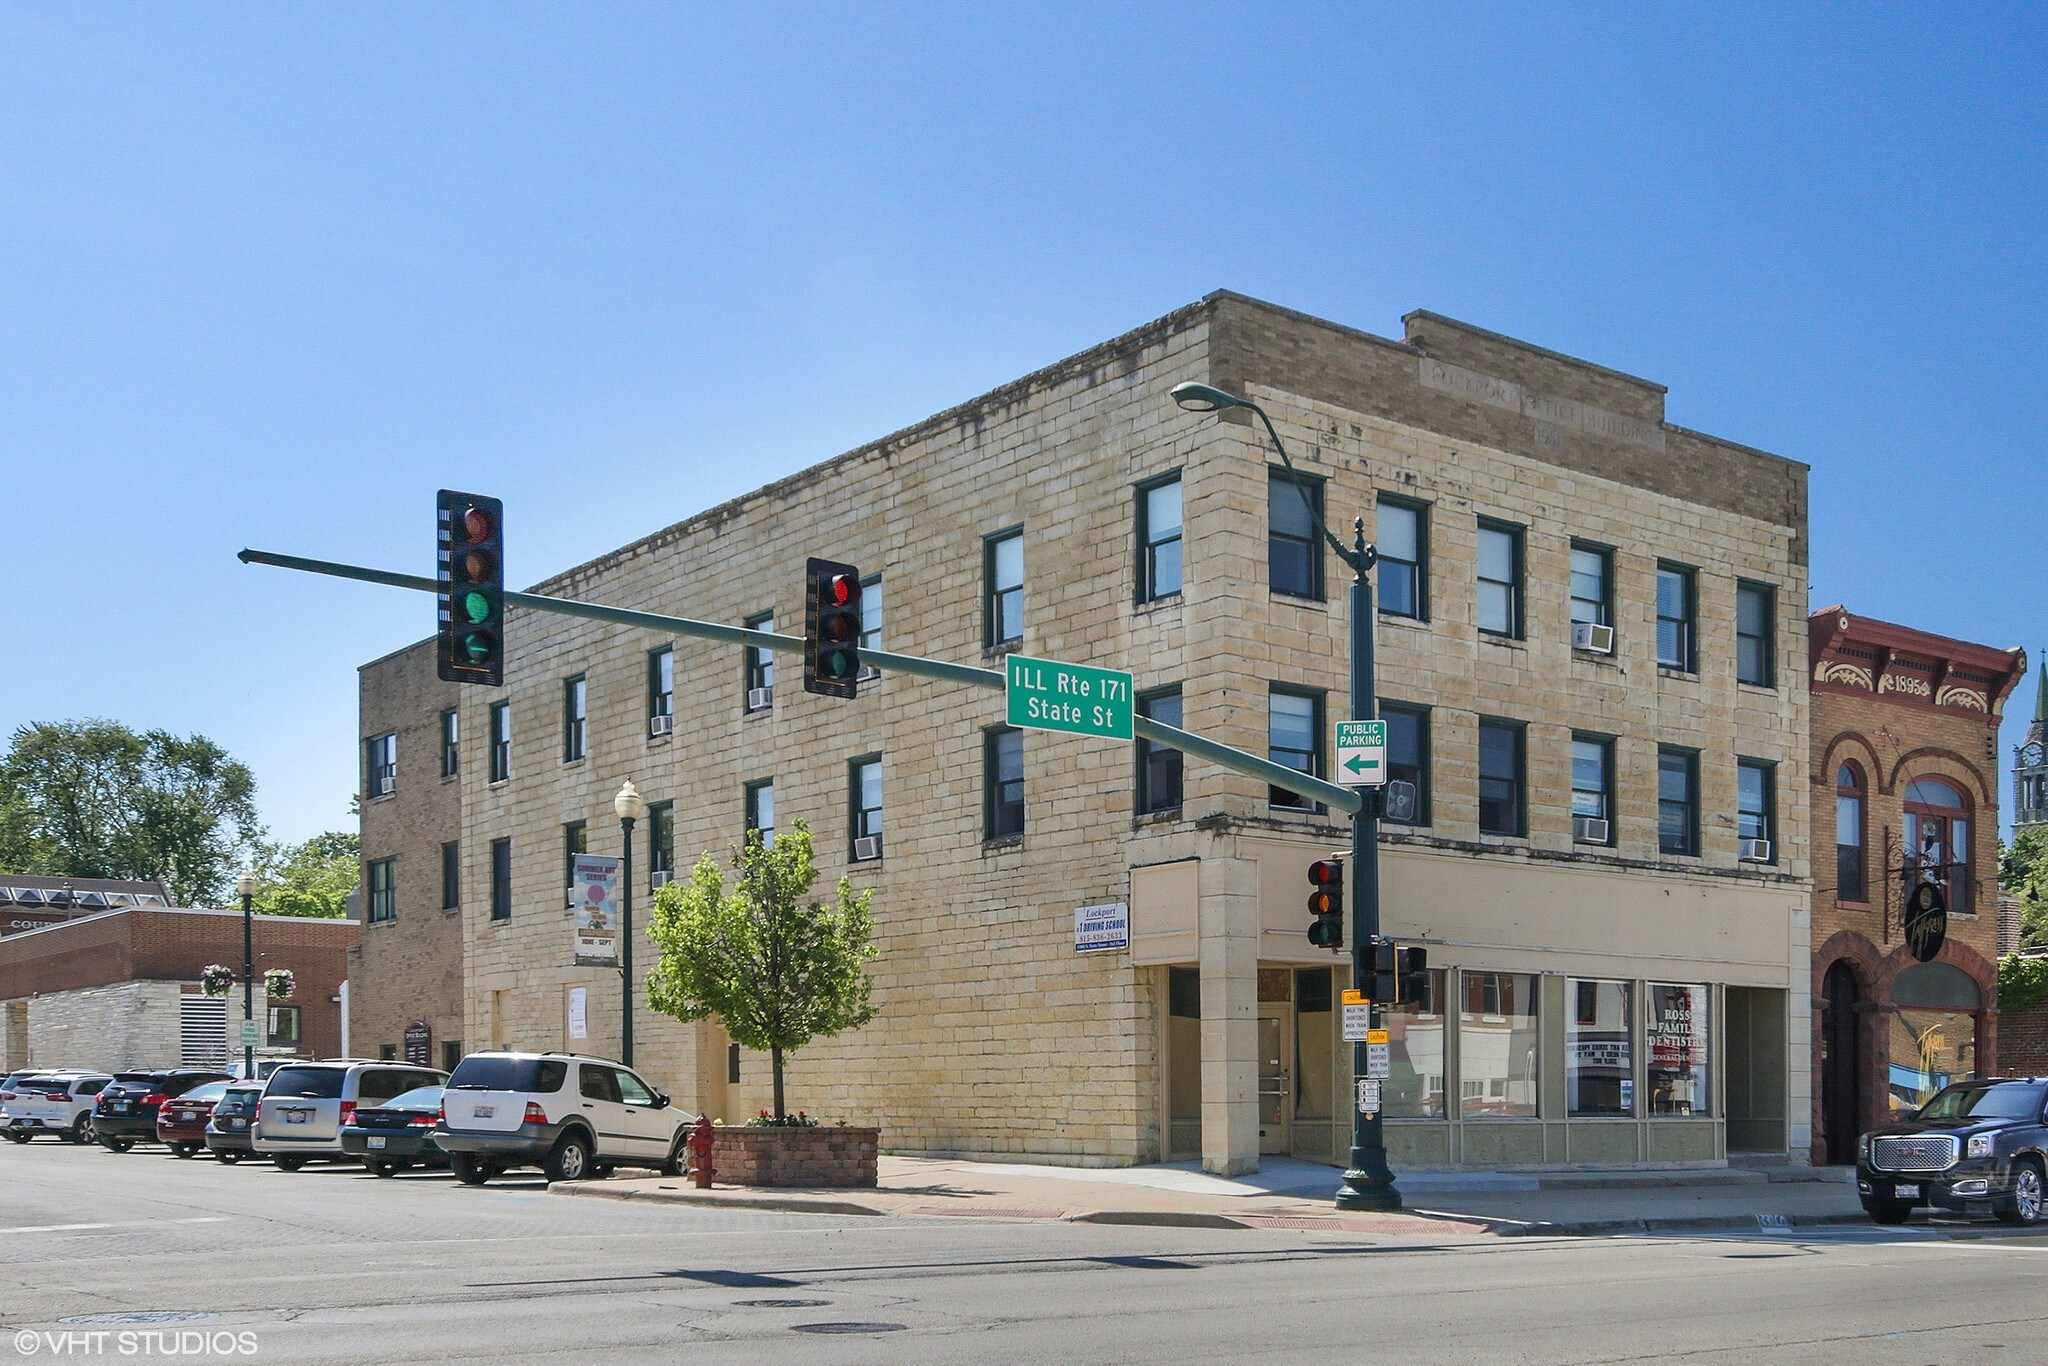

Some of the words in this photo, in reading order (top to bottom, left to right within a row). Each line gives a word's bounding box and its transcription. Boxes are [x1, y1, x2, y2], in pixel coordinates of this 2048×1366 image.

[1015, 666, 1047, 691] ILL
[1057, 672, 1090, 697] Rte
[1100, 678, 1126, 702] 171
[1895, 675, 1920, 695] 1895
[1028, 696, 1082, 723] State
[1092, 705, 1113, 728] St
[1343, 724, 1379, 735] PUBLIC
[1340, 735, 1382, 746] PARKING
[1086, 908, 1116, 918] Lockport
[1083, 921, 1104, 932] DRIVING
[1105, 919, 1126, 930] SCHOOL
[1665, 1009, 1691, 1020] ROSS
